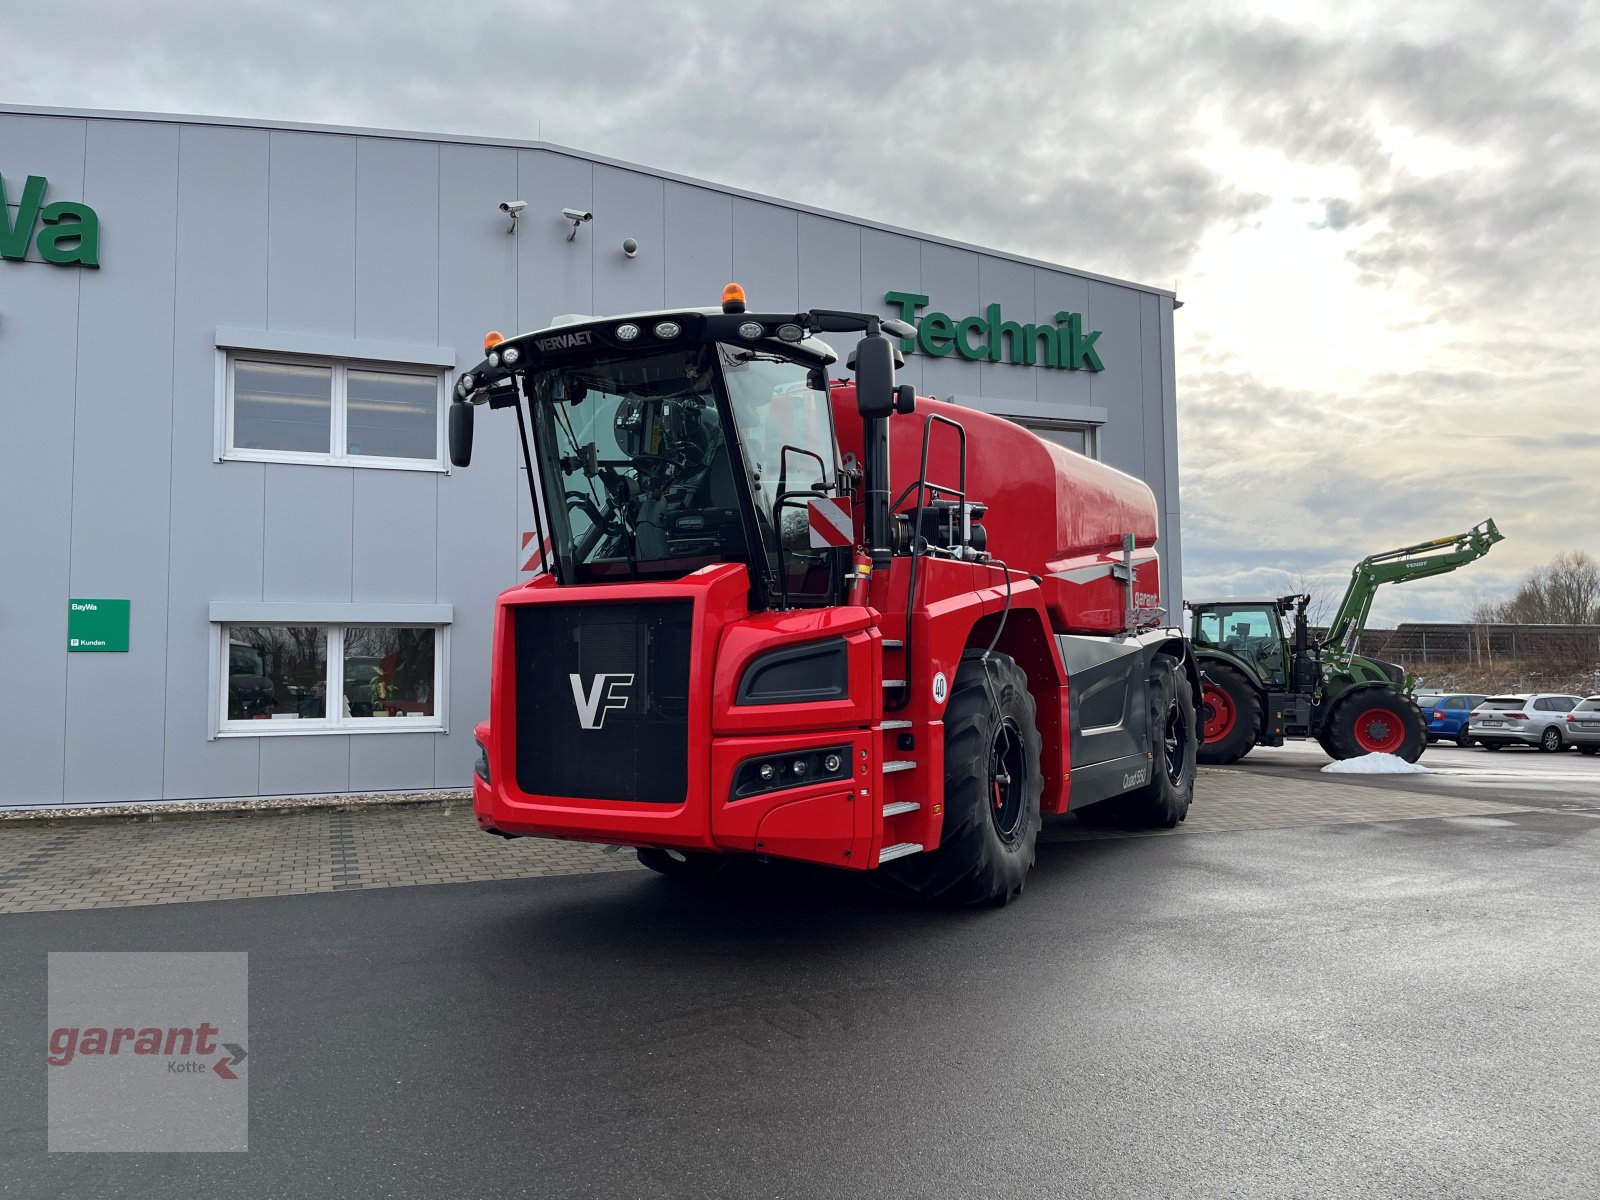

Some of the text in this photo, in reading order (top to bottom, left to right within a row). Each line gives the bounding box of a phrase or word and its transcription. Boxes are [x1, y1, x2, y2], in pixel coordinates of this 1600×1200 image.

[534, 330, 592, 352] VERVAET
[885, 291, 1105, 372] Technik
[1406, 560, 1428, 568] FENDT
[71, 603, 98, 612] BayWa
[1135, 592, 1157, 608] garant
[935, 678, 945, 697] 40
[569, 673, 635, 730] VF
[1122, 767, 1147, 790] Quad 550
